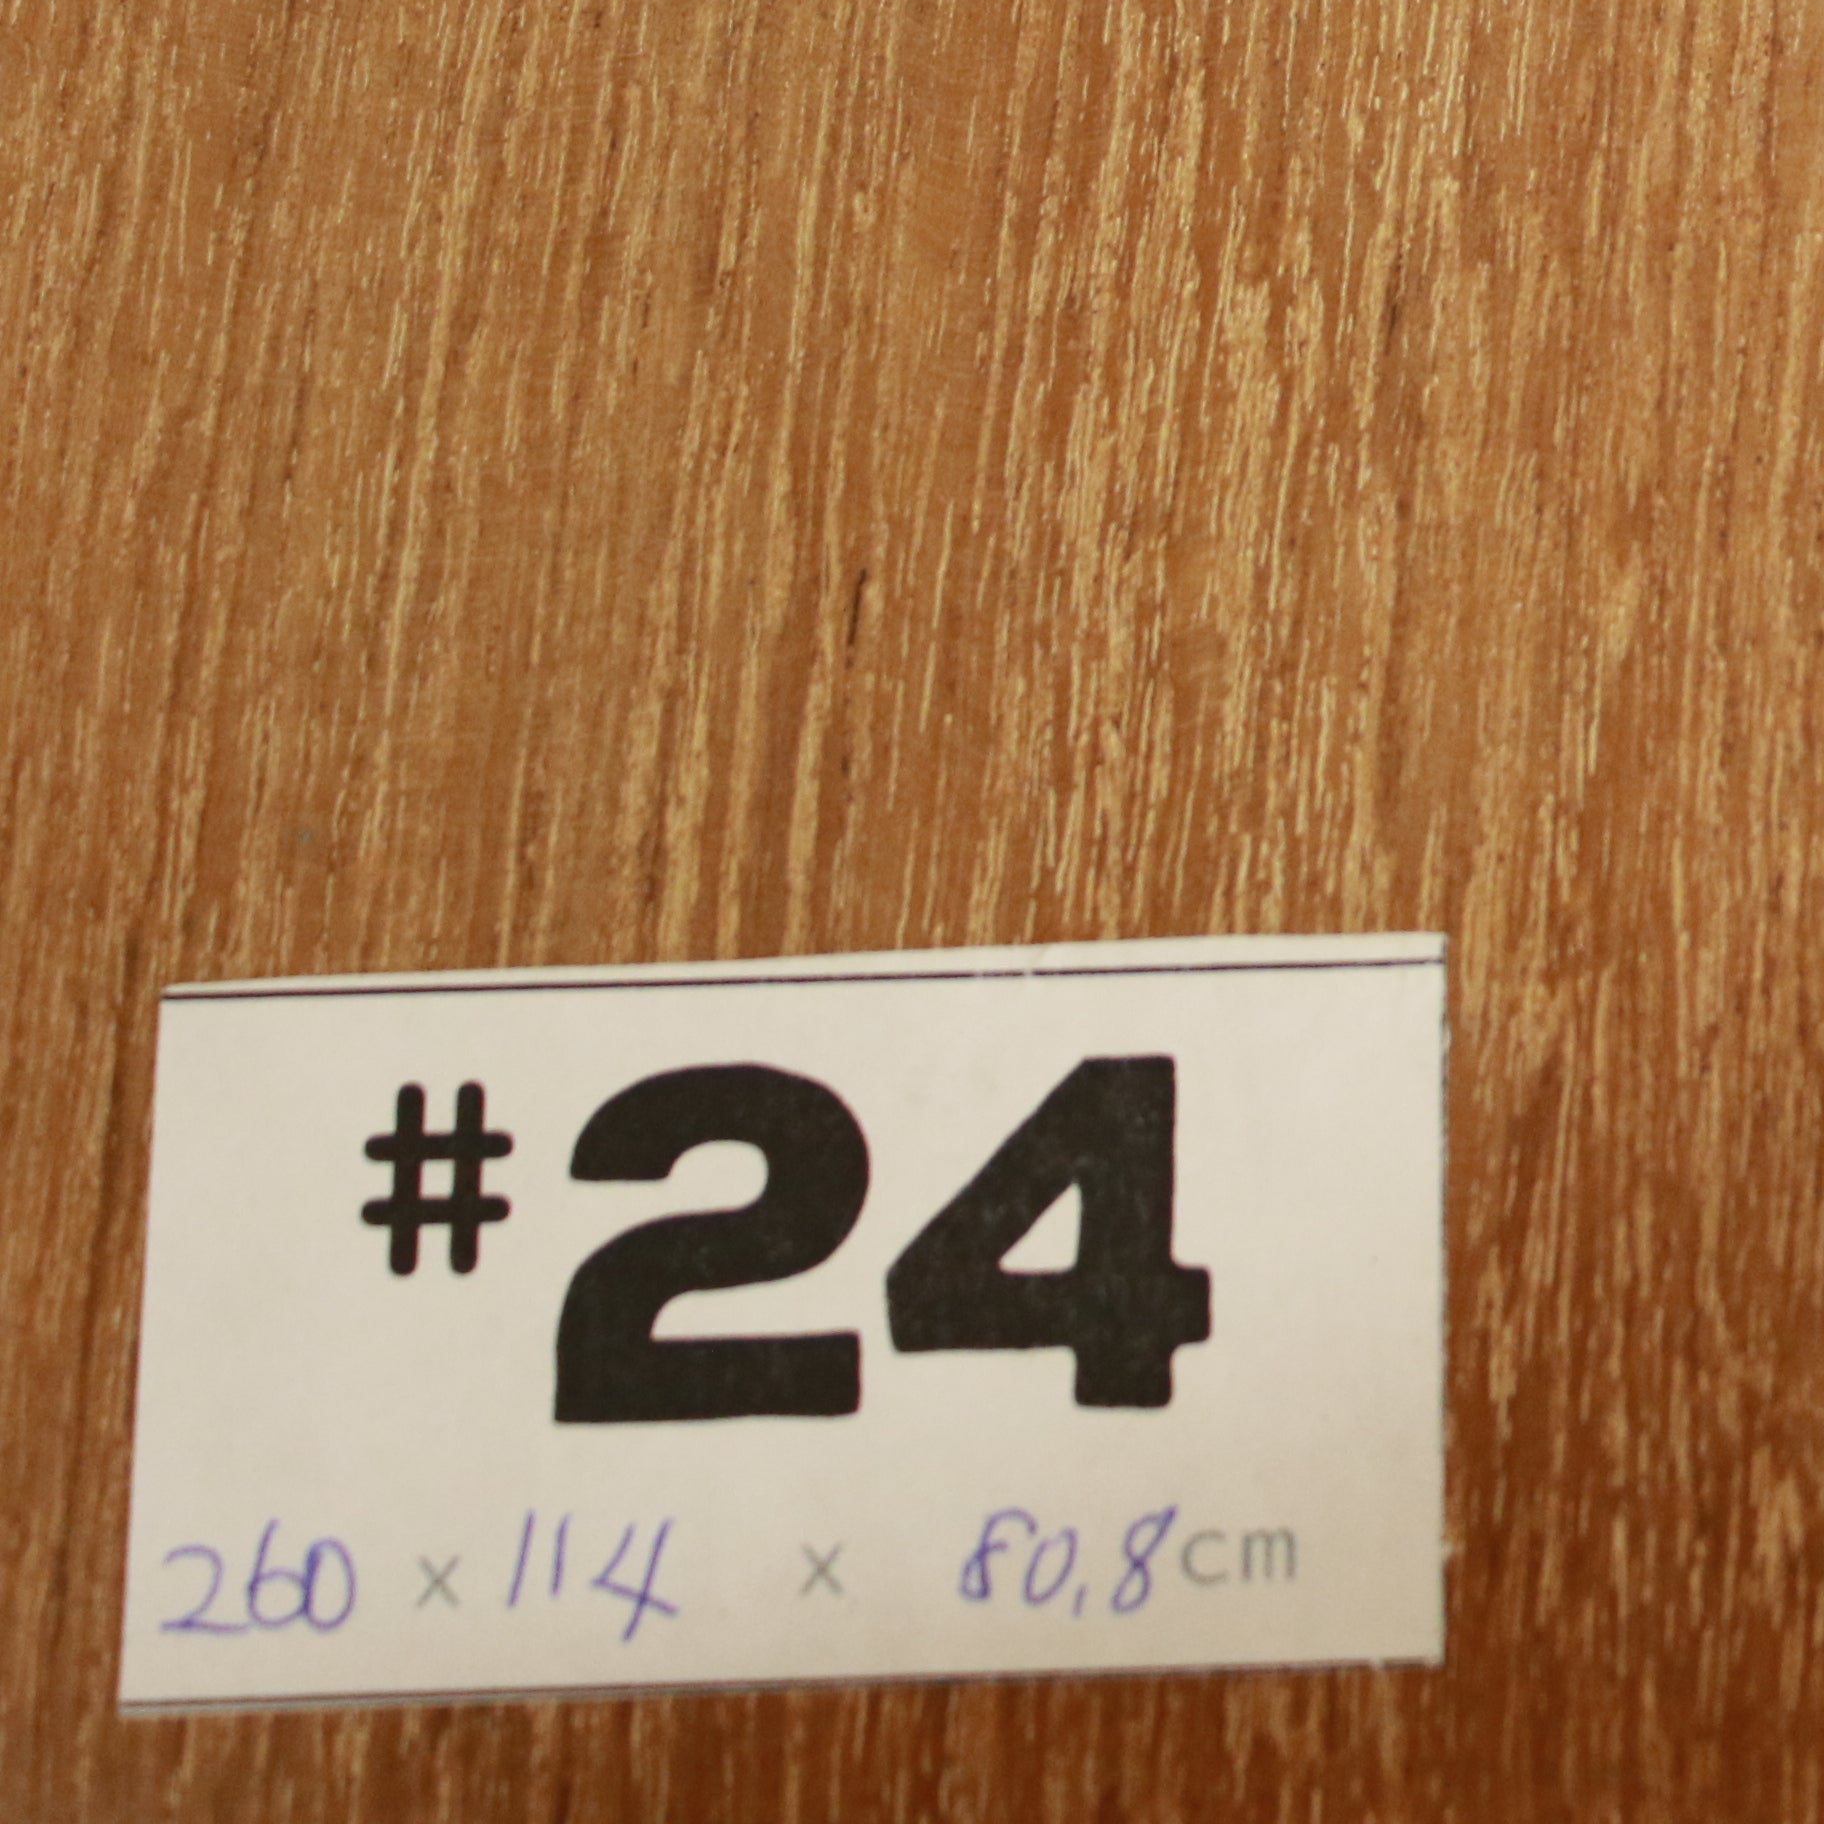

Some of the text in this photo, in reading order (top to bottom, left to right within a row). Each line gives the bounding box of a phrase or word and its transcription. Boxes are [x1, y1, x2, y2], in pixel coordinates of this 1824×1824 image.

[360, 1053, 1213, 1426] #24
[159, 1518, 357, 1635] 260
[507, 1508, 679, 1643] 114
